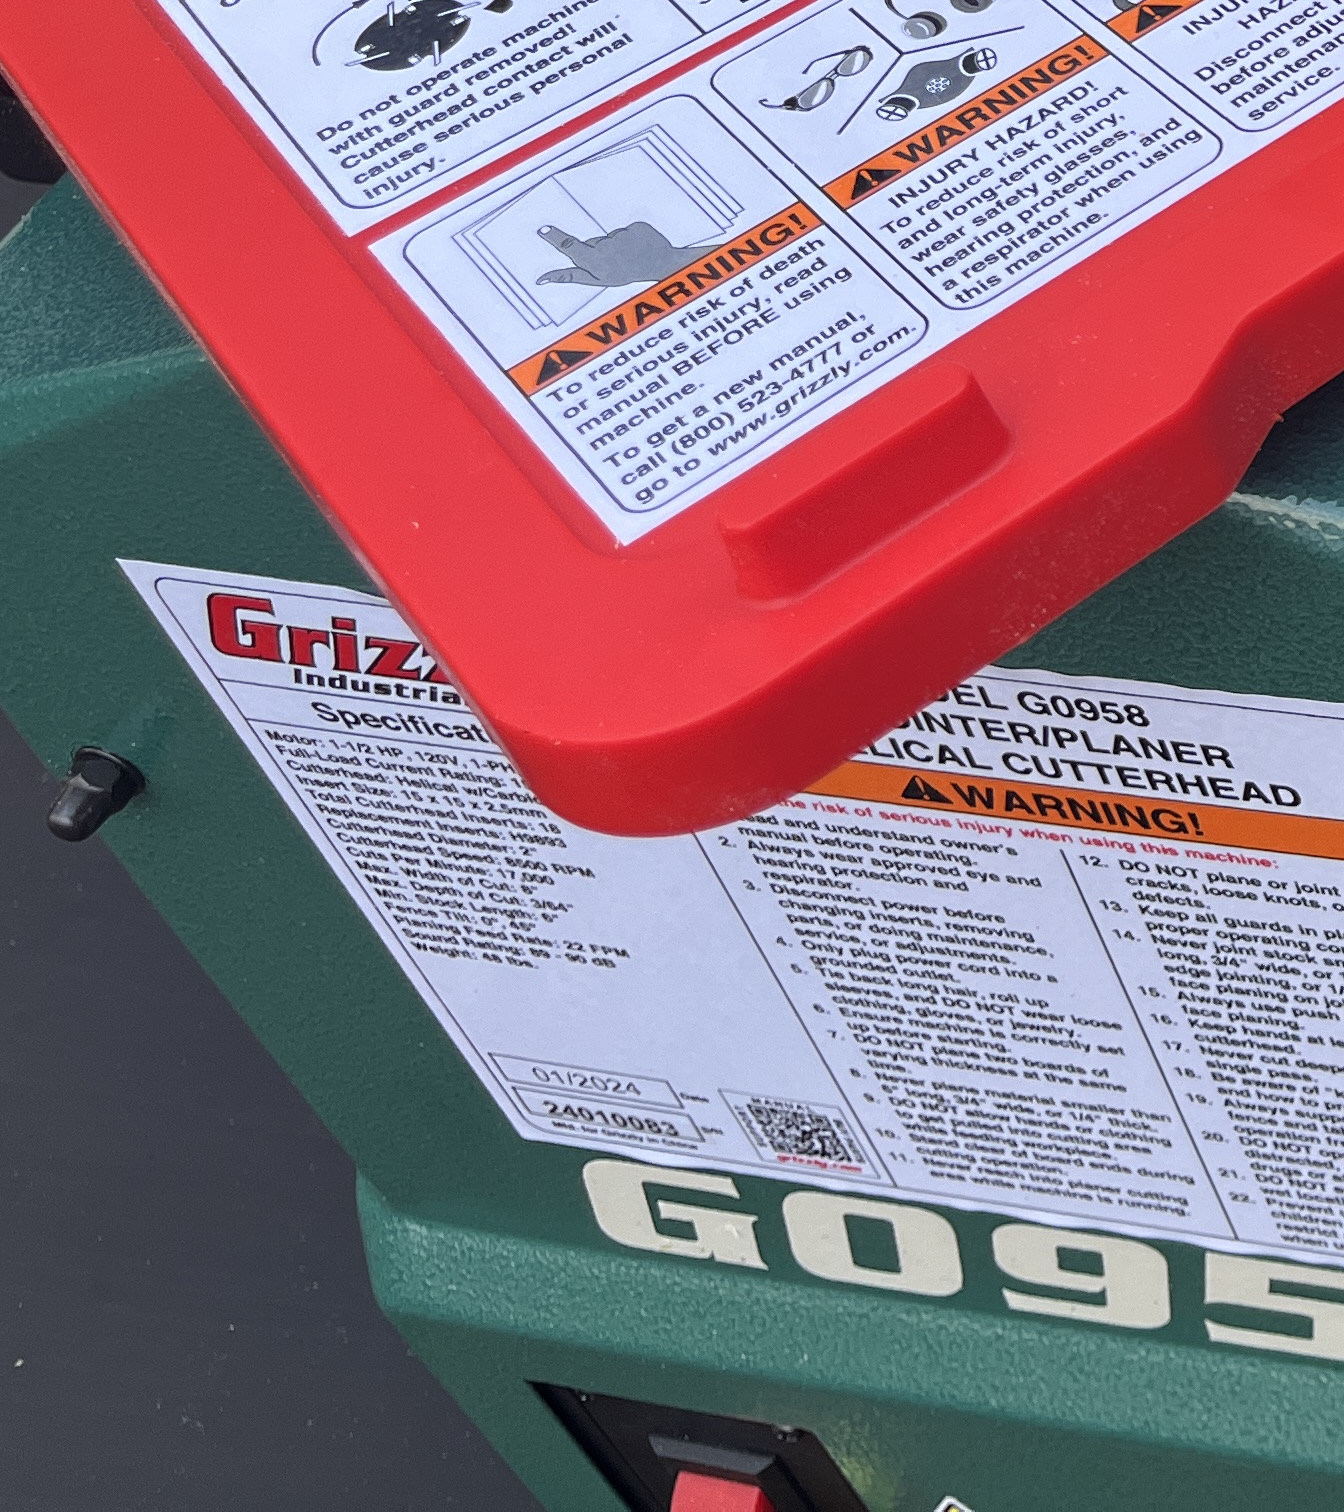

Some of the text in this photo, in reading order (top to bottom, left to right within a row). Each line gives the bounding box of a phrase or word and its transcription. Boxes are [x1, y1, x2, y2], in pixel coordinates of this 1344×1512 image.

[315, 119, 353, 142] Do
[358, 94, 401, 120] not
[405, 46, 497, 96] operate
[327, 22, 577, 155] with guard removed!
[339, 20, 618, 169] Cutterhead contact will
[1193, 0, 1328, 82] Disconnect
[1209, 46, 1290, 95] before
[1247, 66, 1340, 121] service.
[353, 32, 634, 184] cause serious personal
[878, 85, 1129, 234] To reduce risk of short
[887, 80, 1098, 208] INJURY HAZARD!
[891, 44, 1094, 163] WARNING!
[361, 156, 446, 200] injury.
[897, 112, 1125, 250] and long-term injury,
[909, 129, 1136, 262] wear safety glasses,
[923, 116, 1182, 277] hearing protection, and
[941, 128, 1203, 291] a respirator when using
[584, 212, 808, 345] WARNING!
[954, 212, 1109, 304] this machine.
[545, 238, 825, 402] To reduce risk of death
[562, 255, 828, 419] or serious injury, read
[575, 266, 852, 435] manual BEFORE using
[588, 382, 705, 451] machine.
[601, 310, 866, 467] To get a new manual,
[620, 322, 875, 485] call (800) 523-4777 or
[634, 325, 916, 505] go to www.grizzly.com.
[293, 668, 468, 706] Industria
[311, 702, 491, 743] Specificat
[1016, 690, 1150, 727] G0958
[857, 737, 1301, 807] LICAL CUTTERHEAD
[949, 782, 1204, 836] WARNING!
[811, 800, 849, 815] risk
[853, 806, 873, 818] of
[878, 810, 952, 828] serious
[955, 817, 1013, 838] injury
[1018, 827, 1073, 843] when
[1078, 835, 1137, 854] using
[1139, 841, 1179, 856] this
[1183, 848, 1279, 869] machine:
[1078, 854, 1108, 868] 12.
[1117, 858, 1150, 873] DO
[1154, 863, 1198, 879] NOT
[1205, 871, 1262, 887] plane
[1266, 879, 1288, 890] or
[1293, 880, 1341, 897] joint
[531, 1066, 641, 1096] 01/2024
[542, 1099, 680, 1138] 24010083
